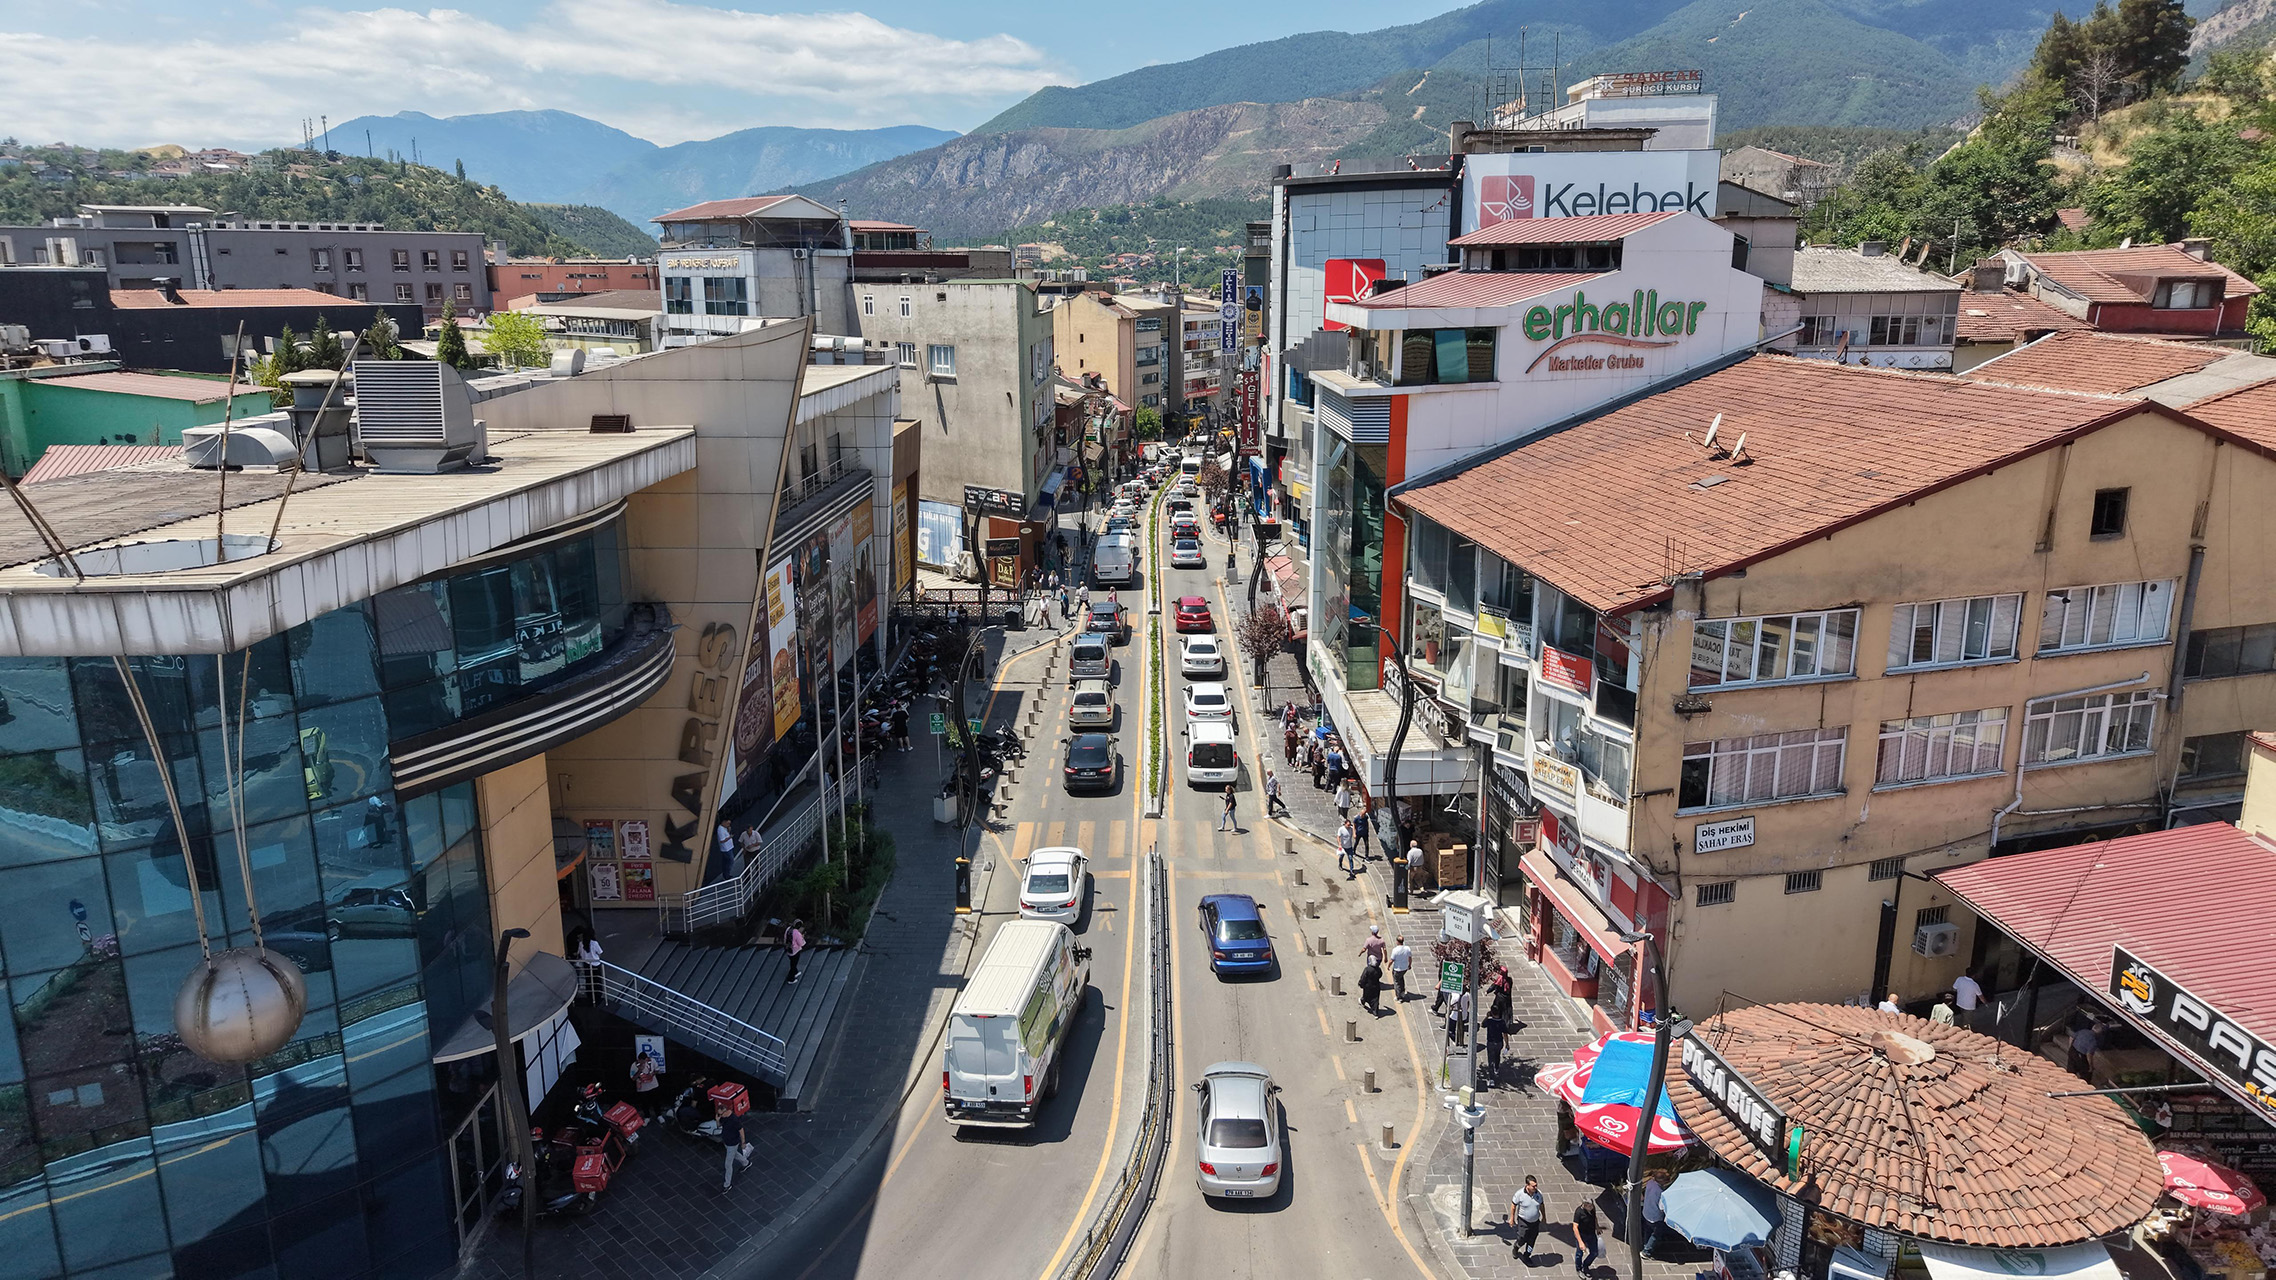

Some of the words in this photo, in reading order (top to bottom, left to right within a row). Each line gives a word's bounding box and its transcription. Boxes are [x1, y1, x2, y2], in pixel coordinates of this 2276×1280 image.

[1624, 69, 1700, 83] SANCAK
[1622, 83, 1663, 94] SÜRÜCÜ
[1666, 82, 1700, 92] KURSU
[1544, 182, 1710, 218] Kelebek
[1523, 289, 1707, 341] erhallar
[1548, 355, 1605, 372] Marketler
[1607, 354, 1645, 370] Grubu
[660, 622, 737, 864] KARES
[1702, 827, 1716, 837] DİŞ
[1719, 821, 1750, 835] HEKİMİ
[1699, 837, 1728, 851] ŞAHAP
[1731, 833, 1753, 844] ERAŞ
[1727, 1081, 1776, 1147] BÜFE
[1594, 1125, 1620, 1138] ALGIDA
[2207, 1203, 2234, 1212] ALGIDA
